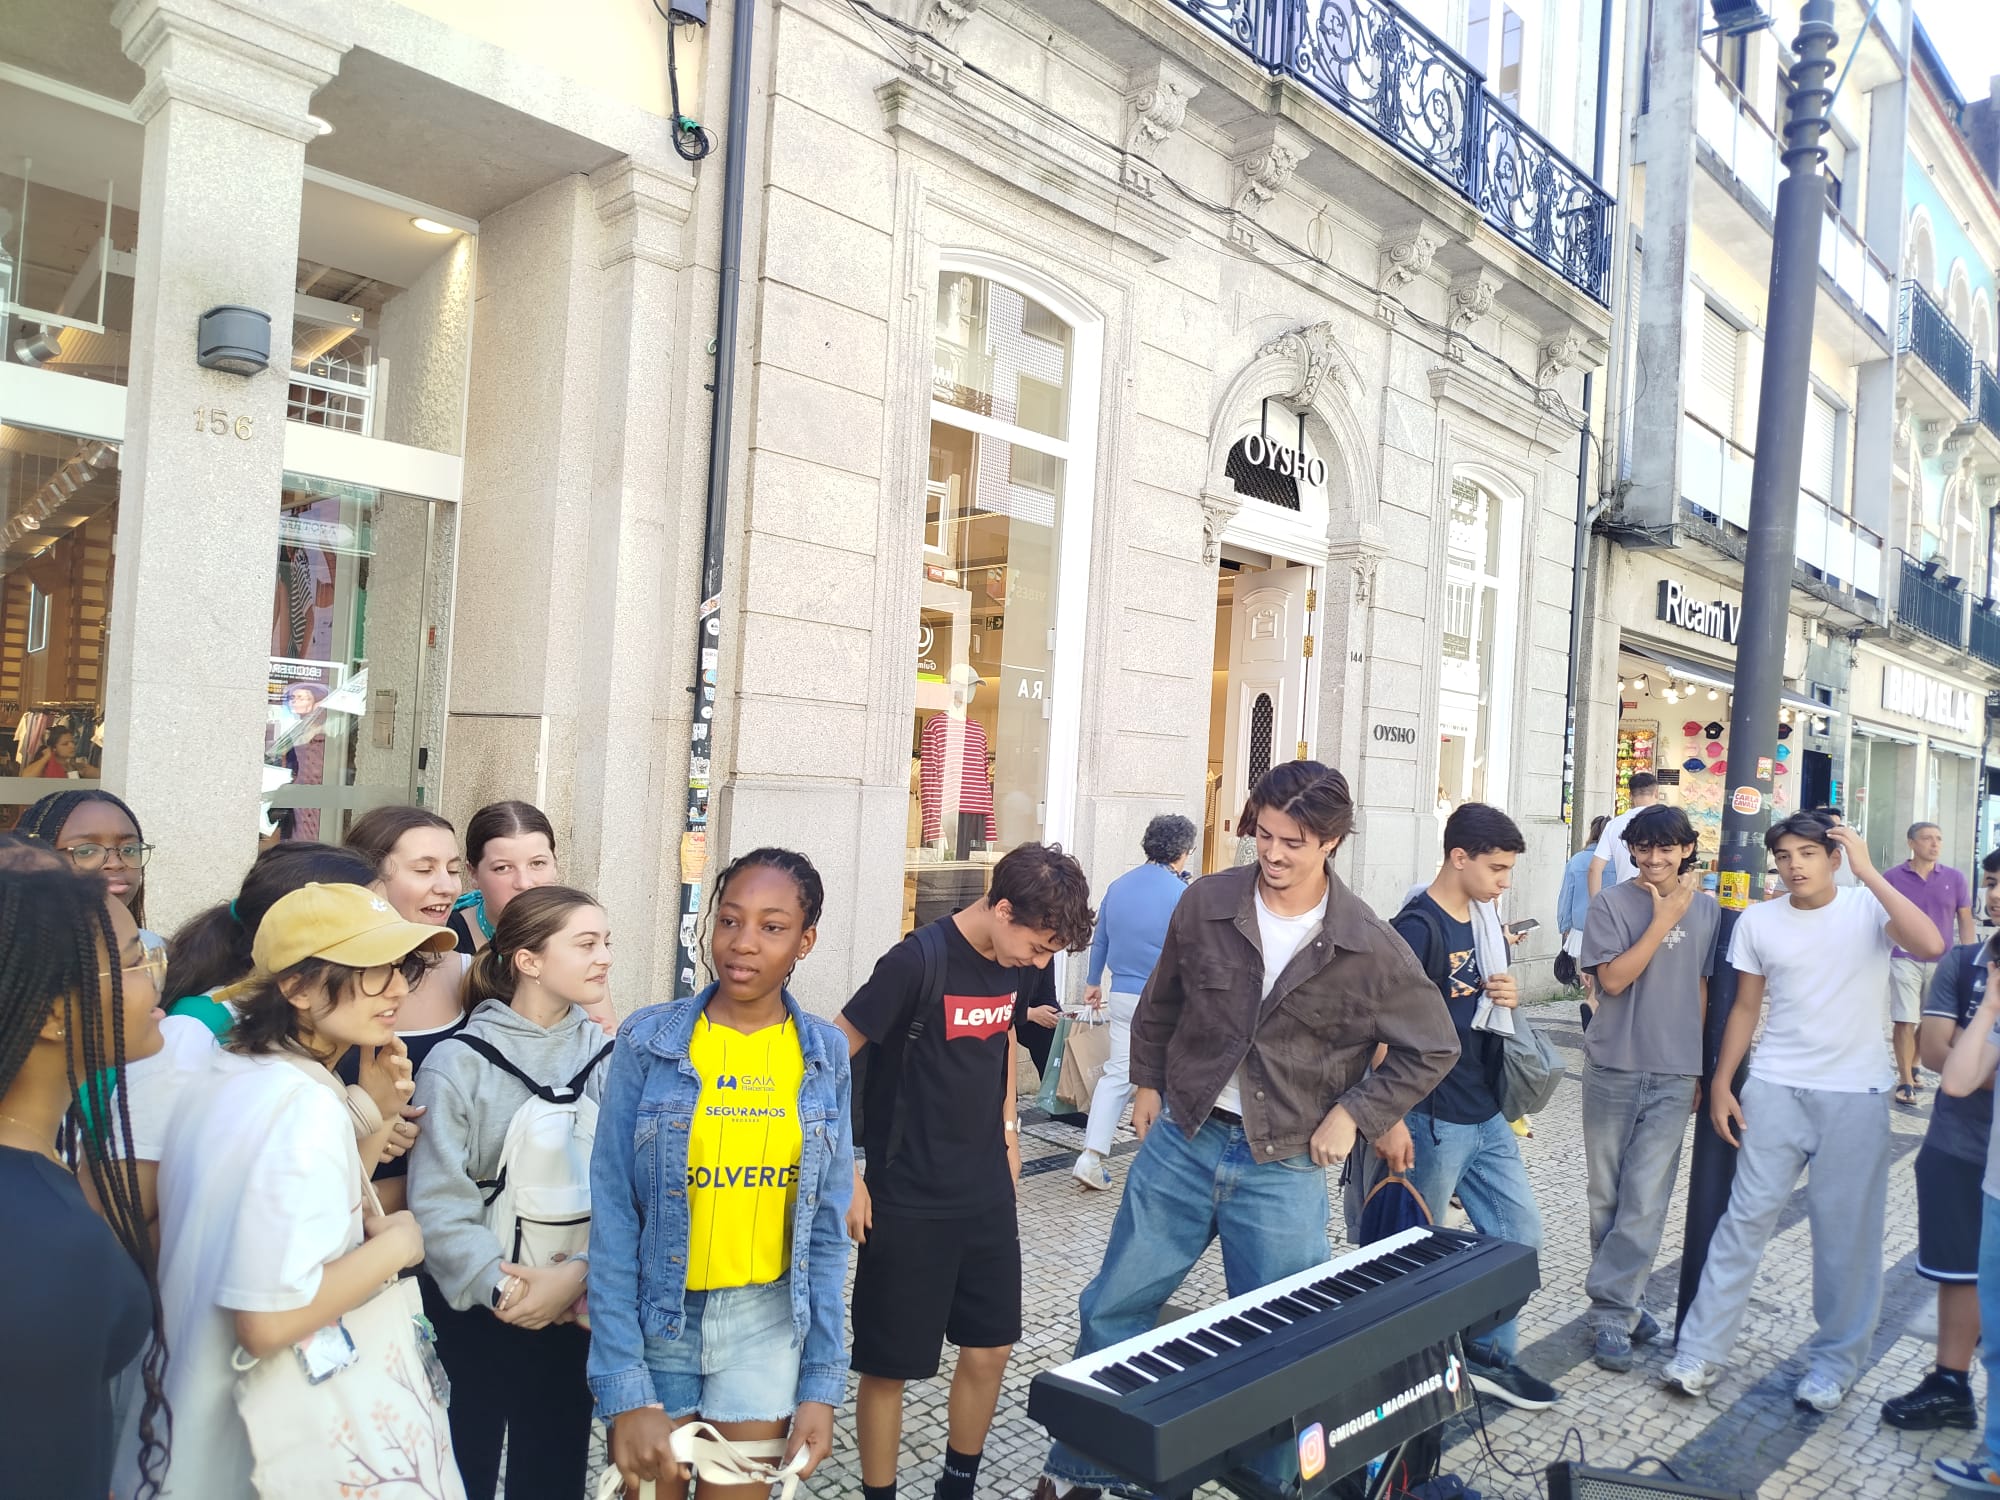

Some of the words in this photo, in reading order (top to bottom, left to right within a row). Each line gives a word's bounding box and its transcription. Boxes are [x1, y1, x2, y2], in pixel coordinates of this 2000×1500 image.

[193, 406, 253, 440] 156
[1244, 433, 1328, 488] OYSHO
[1665, 579, 1726, 641] Ricami
[1350, 651, 1363, 663] 144
[1886, 665, 1975, 733] BRUXELAS
[1373, 724, 1415, 744] OYSHO
[741, 1075, 775, 1086] GAIA
[705, 1106, 786, 1118] SEGURAMOS
